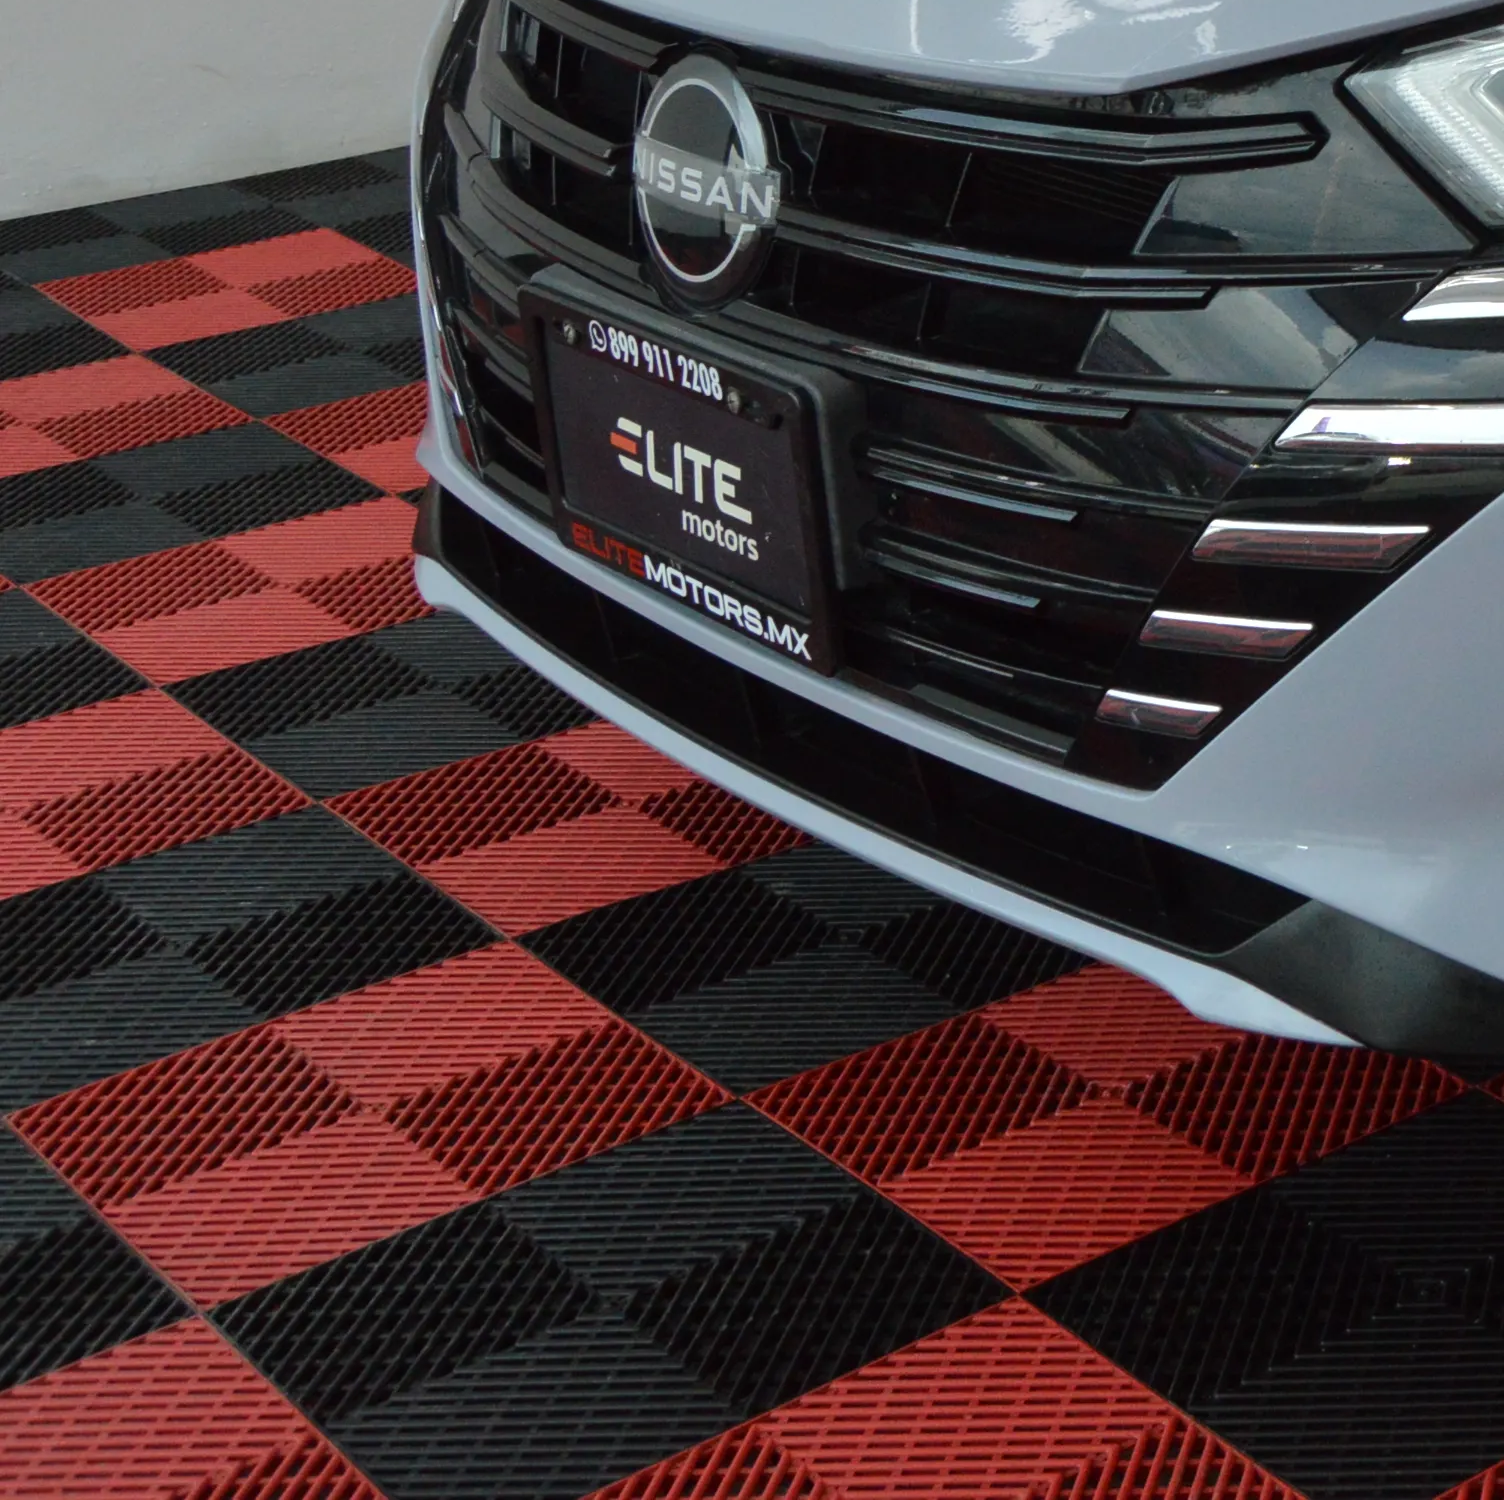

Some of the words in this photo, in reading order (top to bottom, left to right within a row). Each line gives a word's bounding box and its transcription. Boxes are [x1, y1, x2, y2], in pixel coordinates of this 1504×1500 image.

[633, 145, 775, 218] NISSAN
[607, 326, 639, 368] 899
[642, 340, 674, 382] 911
[677, 355, 723, 400] 2208
[610, 416, 752, 525] ELITE
[682, 509, 759, 561] motors
